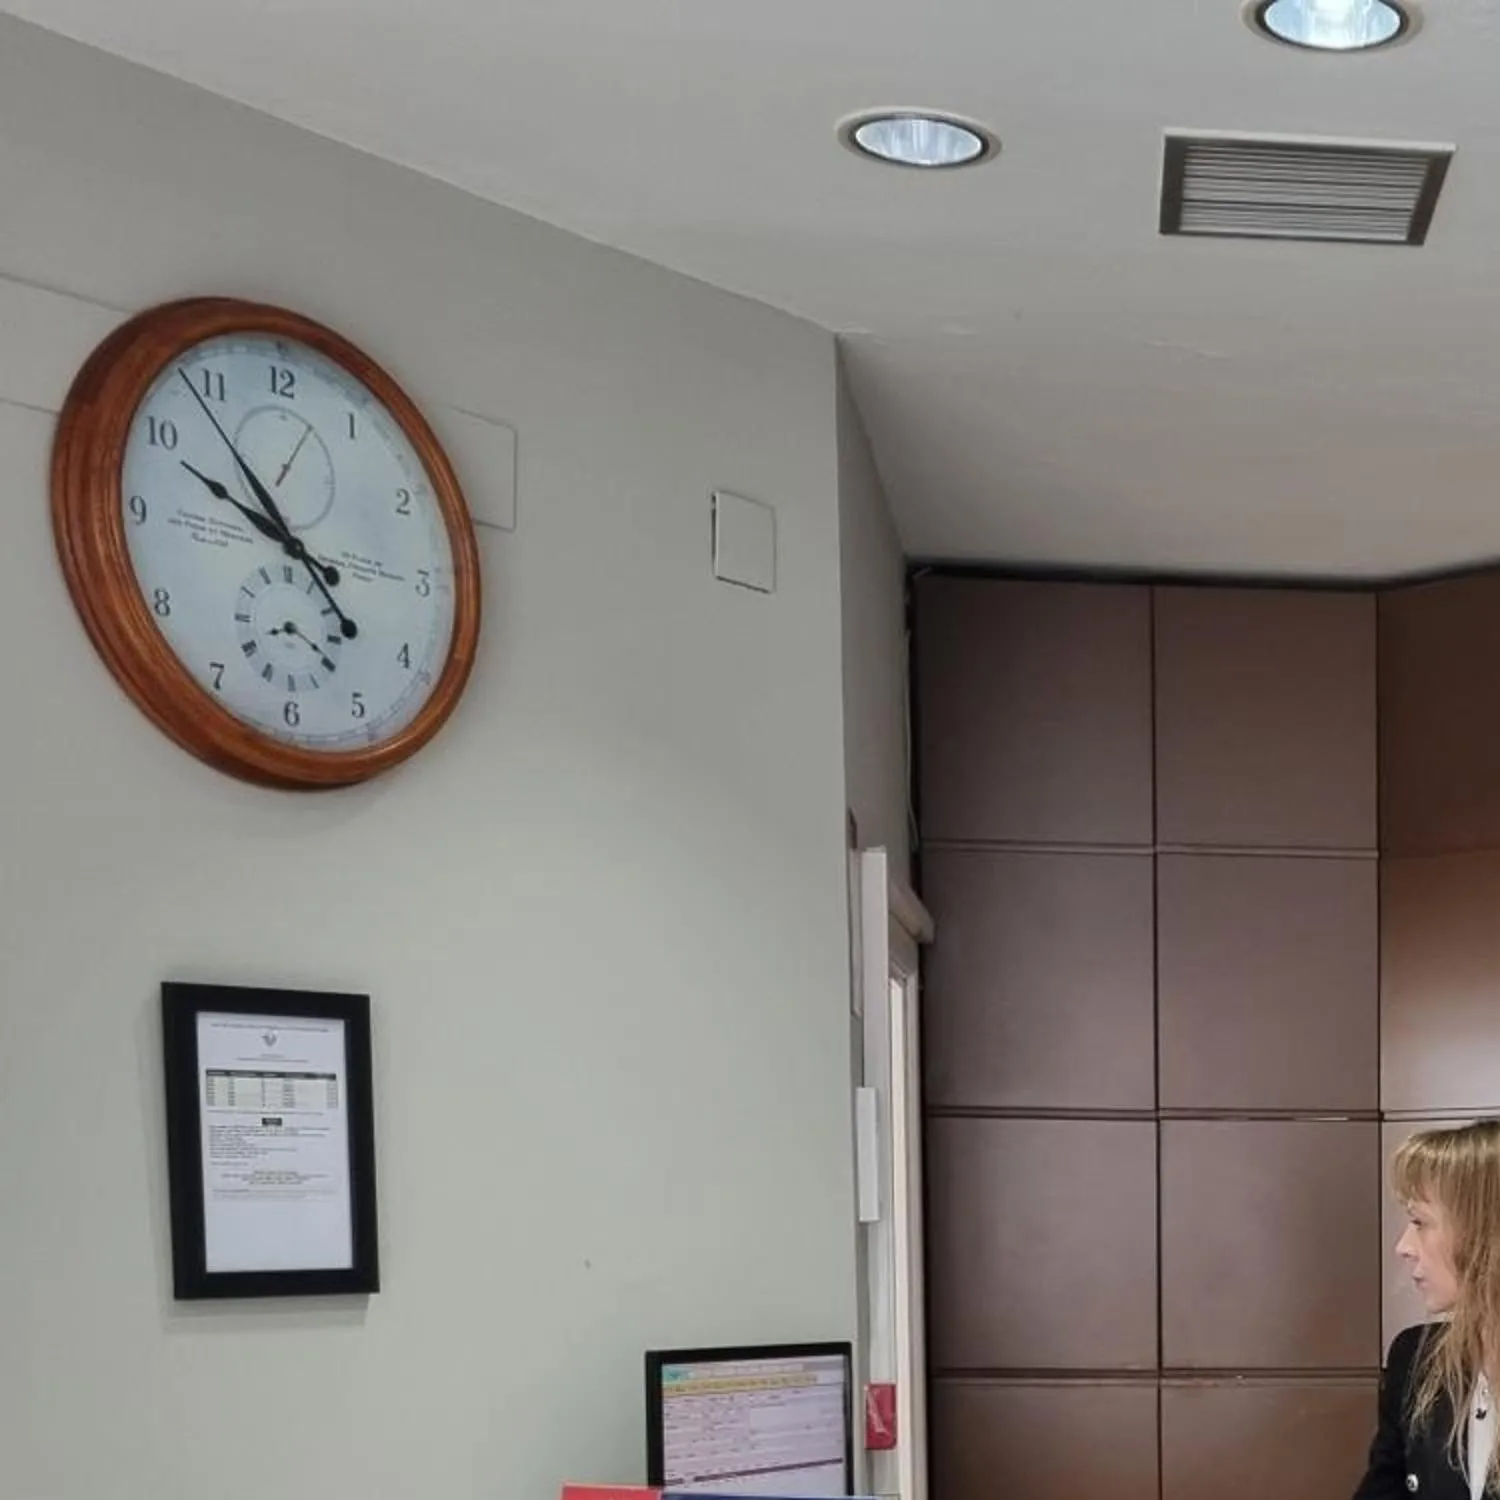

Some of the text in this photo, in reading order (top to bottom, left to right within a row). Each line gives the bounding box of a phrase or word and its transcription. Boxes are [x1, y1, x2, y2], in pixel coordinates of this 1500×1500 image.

[202, 367, 226, 402] 11
[268, 365, 295, 399] 12
[145, 415, 178, 450] 10
[347, 412, 356, 440] 1
[129, 495, 147, 525] 9
[396, 488, 411, 515] 2
[415, 569, 430, 597] 3
[154, 588, 171, 617] 8
[397, 642, 409, 669] 4
[210, 661, 225, 691] 7
[284, 701, 300, 727] 6
[351, 692, 365, 718] 5
